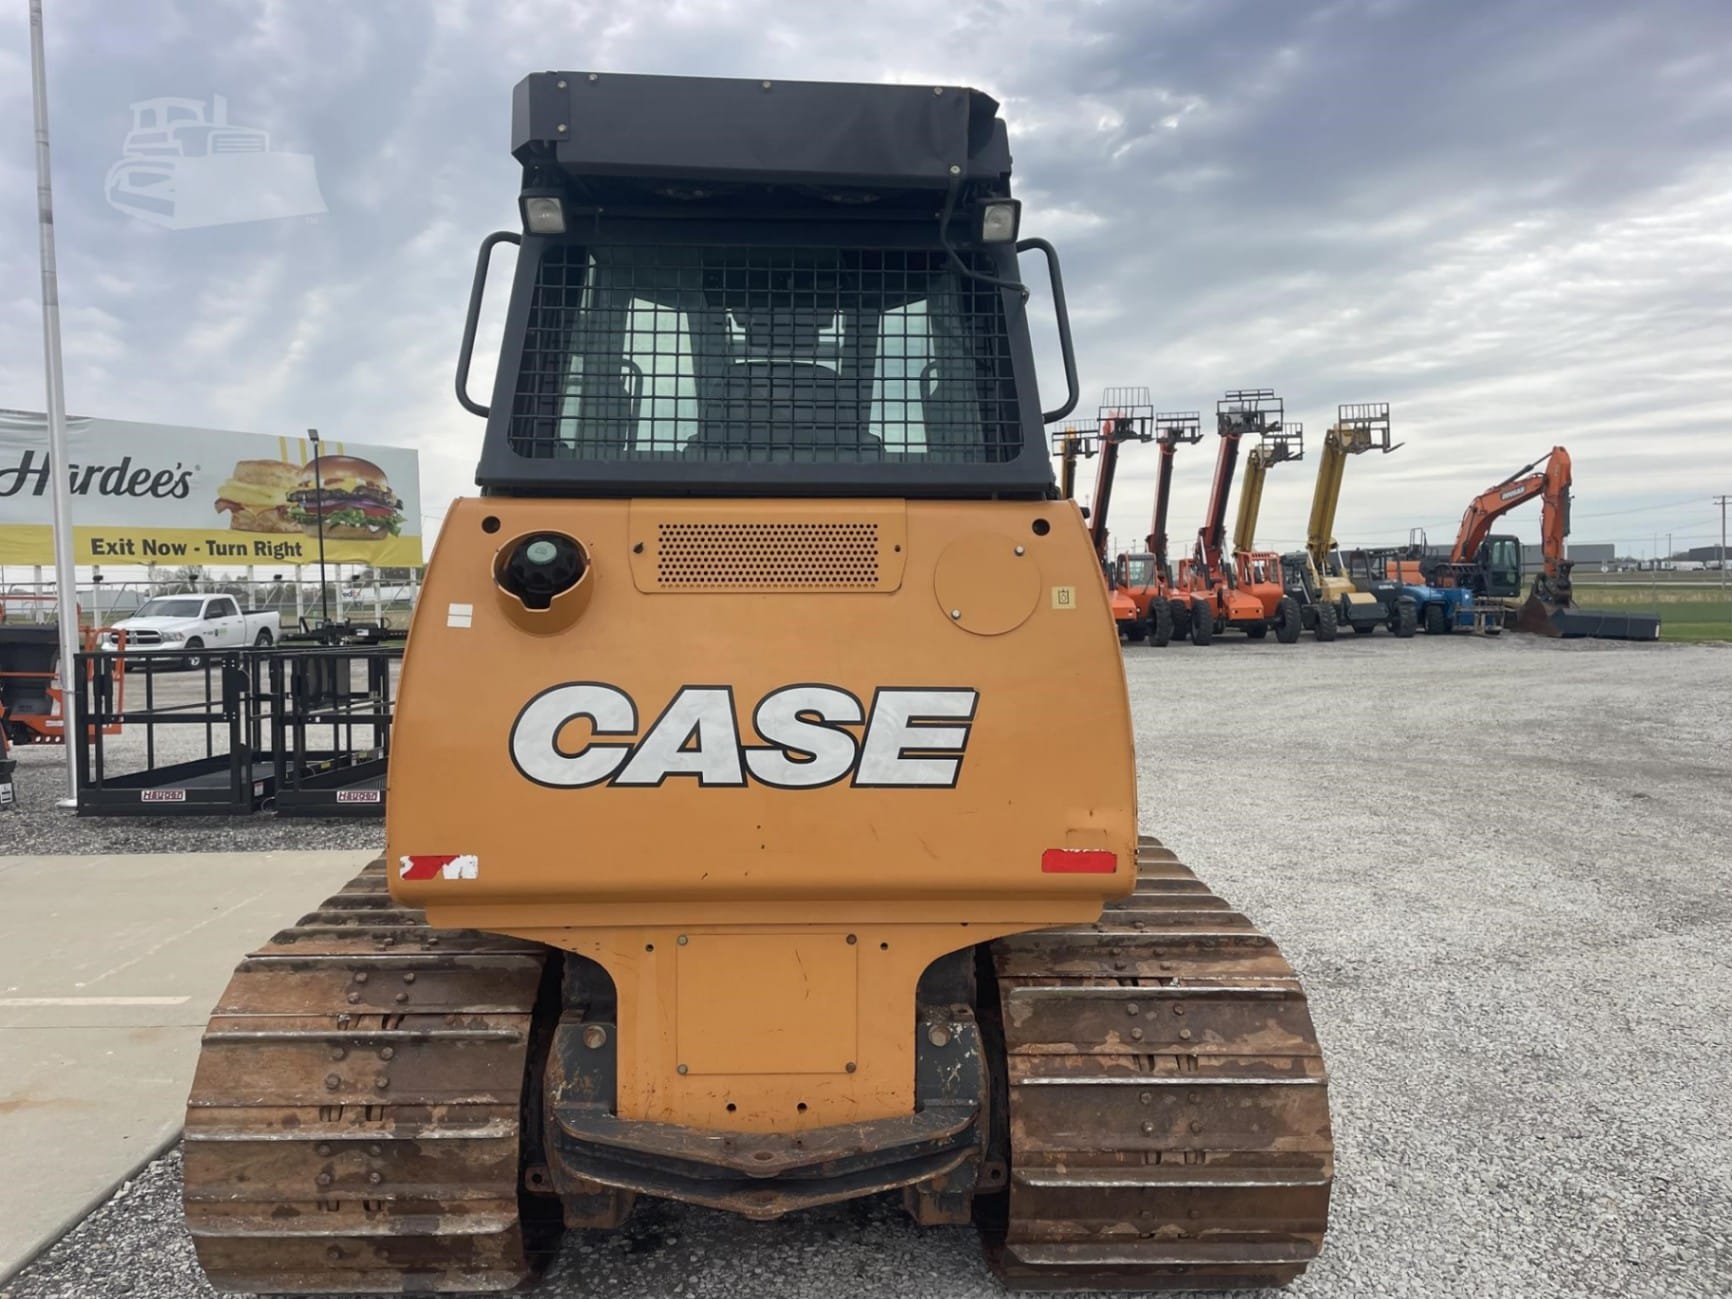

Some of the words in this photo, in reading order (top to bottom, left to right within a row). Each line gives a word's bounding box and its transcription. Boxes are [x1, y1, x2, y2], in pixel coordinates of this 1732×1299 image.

[91, 538, 135, 556] Exit
[142, 539, 187, 556] Now
[205, 540, 248, 556] Turn
[253, 540, 303, 560] Right
[509, 681, 980, 789] CASE
